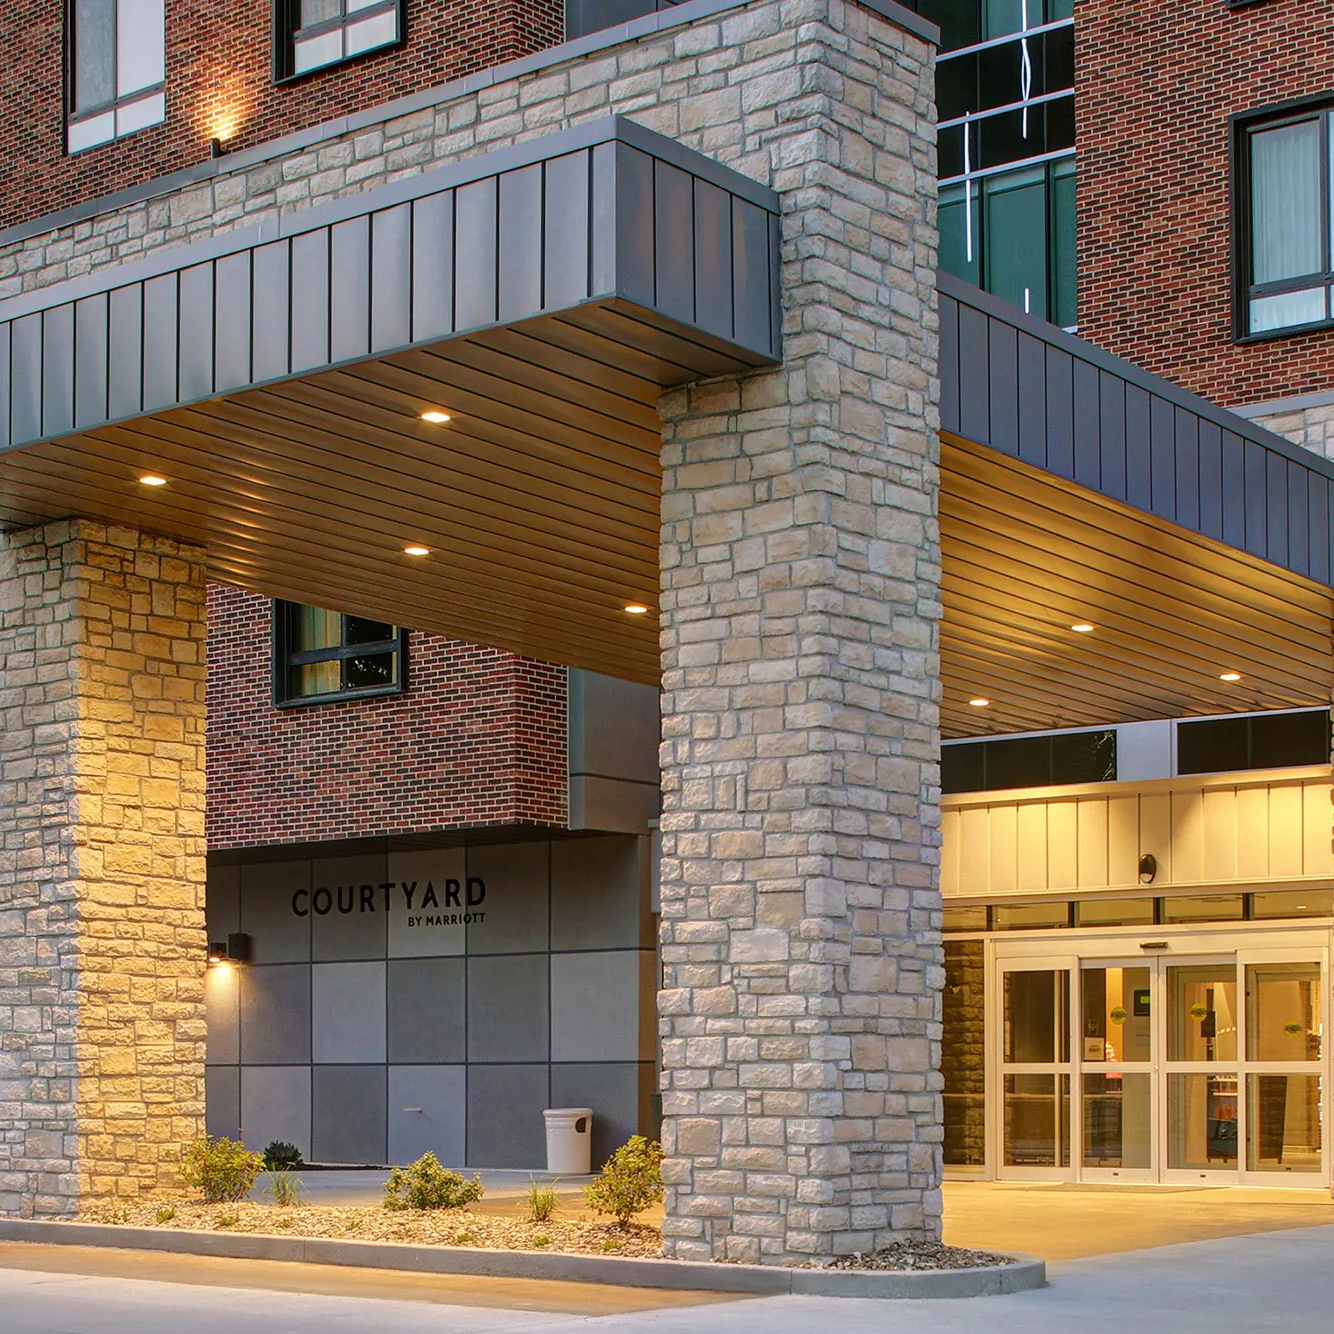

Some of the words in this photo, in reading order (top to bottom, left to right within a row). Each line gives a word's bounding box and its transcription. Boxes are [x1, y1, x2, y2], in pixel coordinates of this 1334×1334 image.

[292, 877, 486, 917] COURTYARD
[408, 916, 422, 927] BY
[426, 913, 486, 926] MARRIOTT
